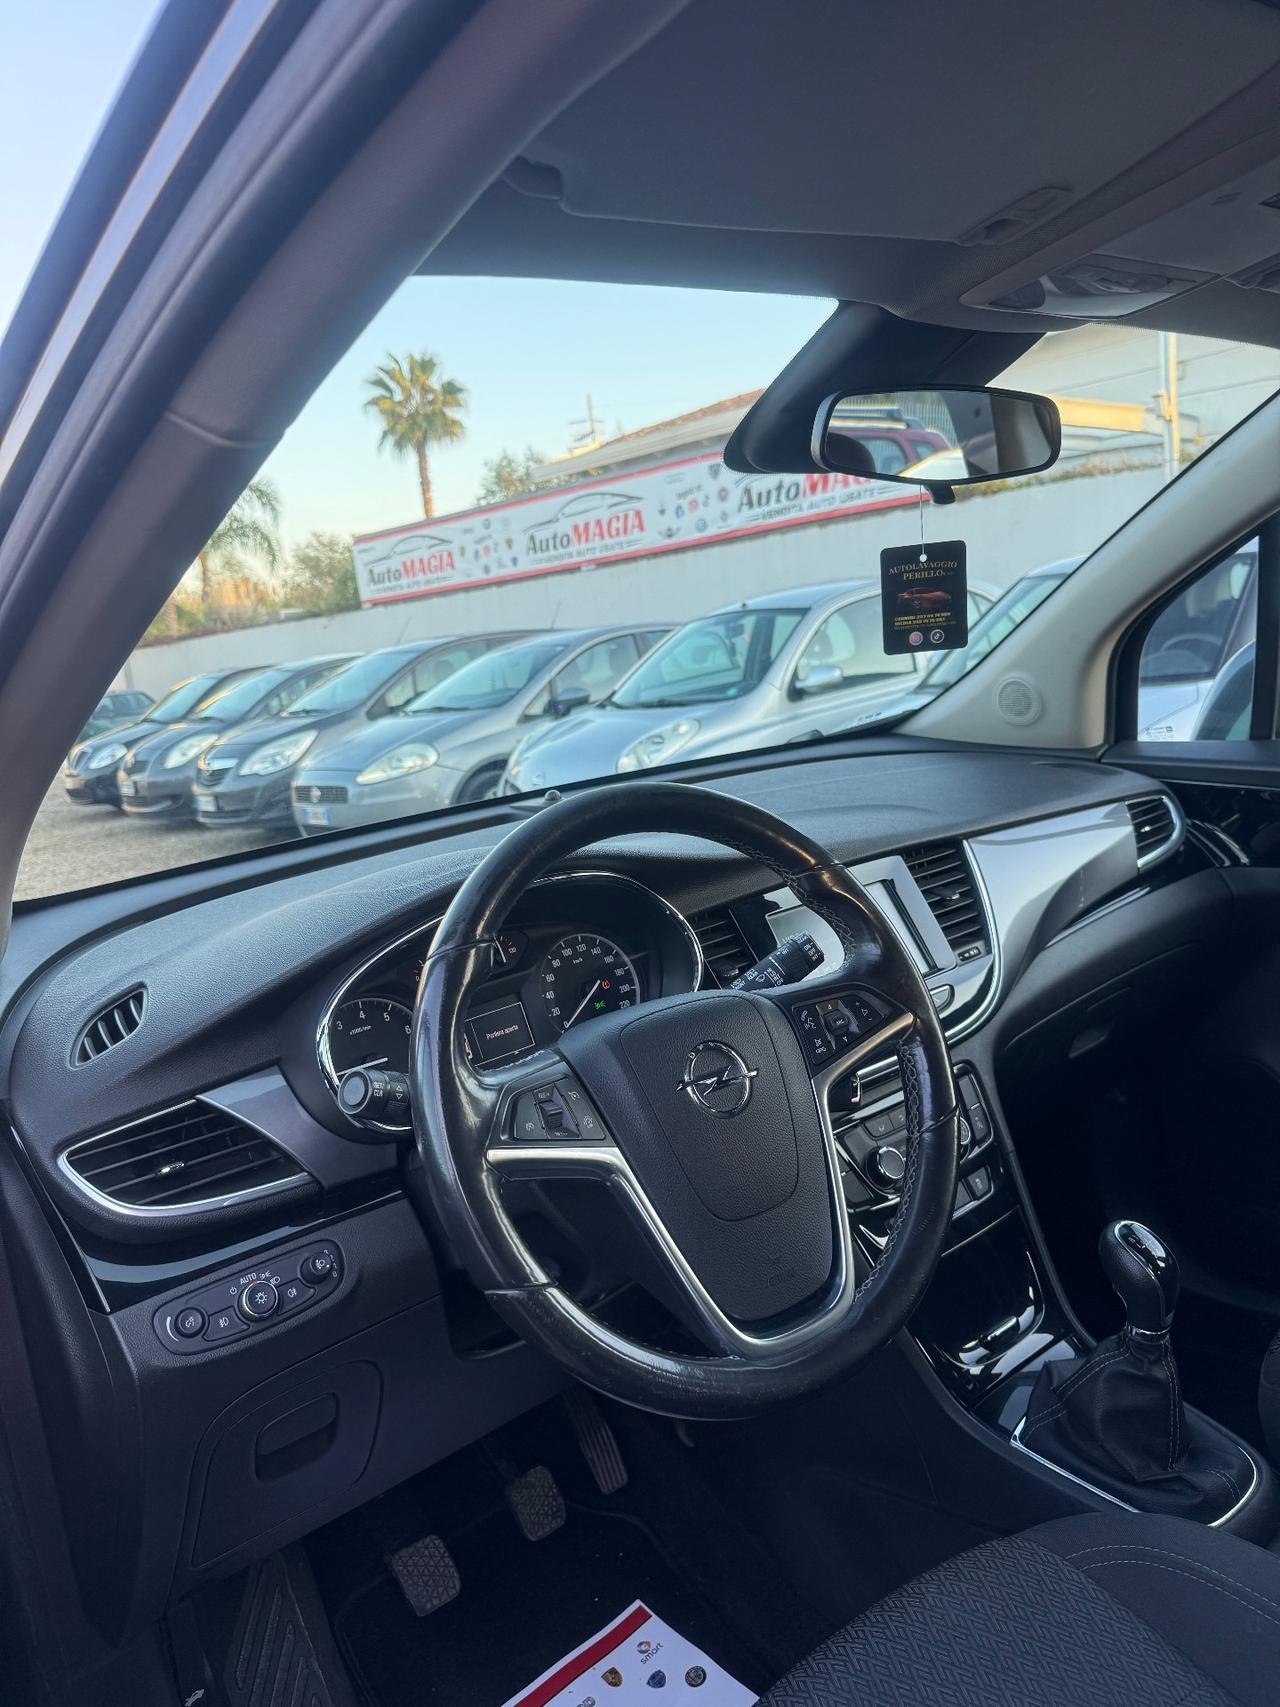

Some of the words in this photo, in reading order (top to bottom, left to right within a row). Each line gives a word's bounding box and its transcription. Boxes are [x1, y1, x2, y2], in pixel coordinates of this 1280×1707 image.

[527, 510, 646, 556] AutoMAGIA
[368, 551, 456, 585] AutoMAGIA
[888, 561, 958, 576] AUTOLAVAGGIO
[903, 569, 944, 580] PERILLO
[359, 1010, 366, 1020] 4
[383, 1012, 390, 1022] 5
[336, 1020, 343, 1030] 3
[239, 1272, 257, 1285] AUTO
[640, 1642, 664, 1665] smart
